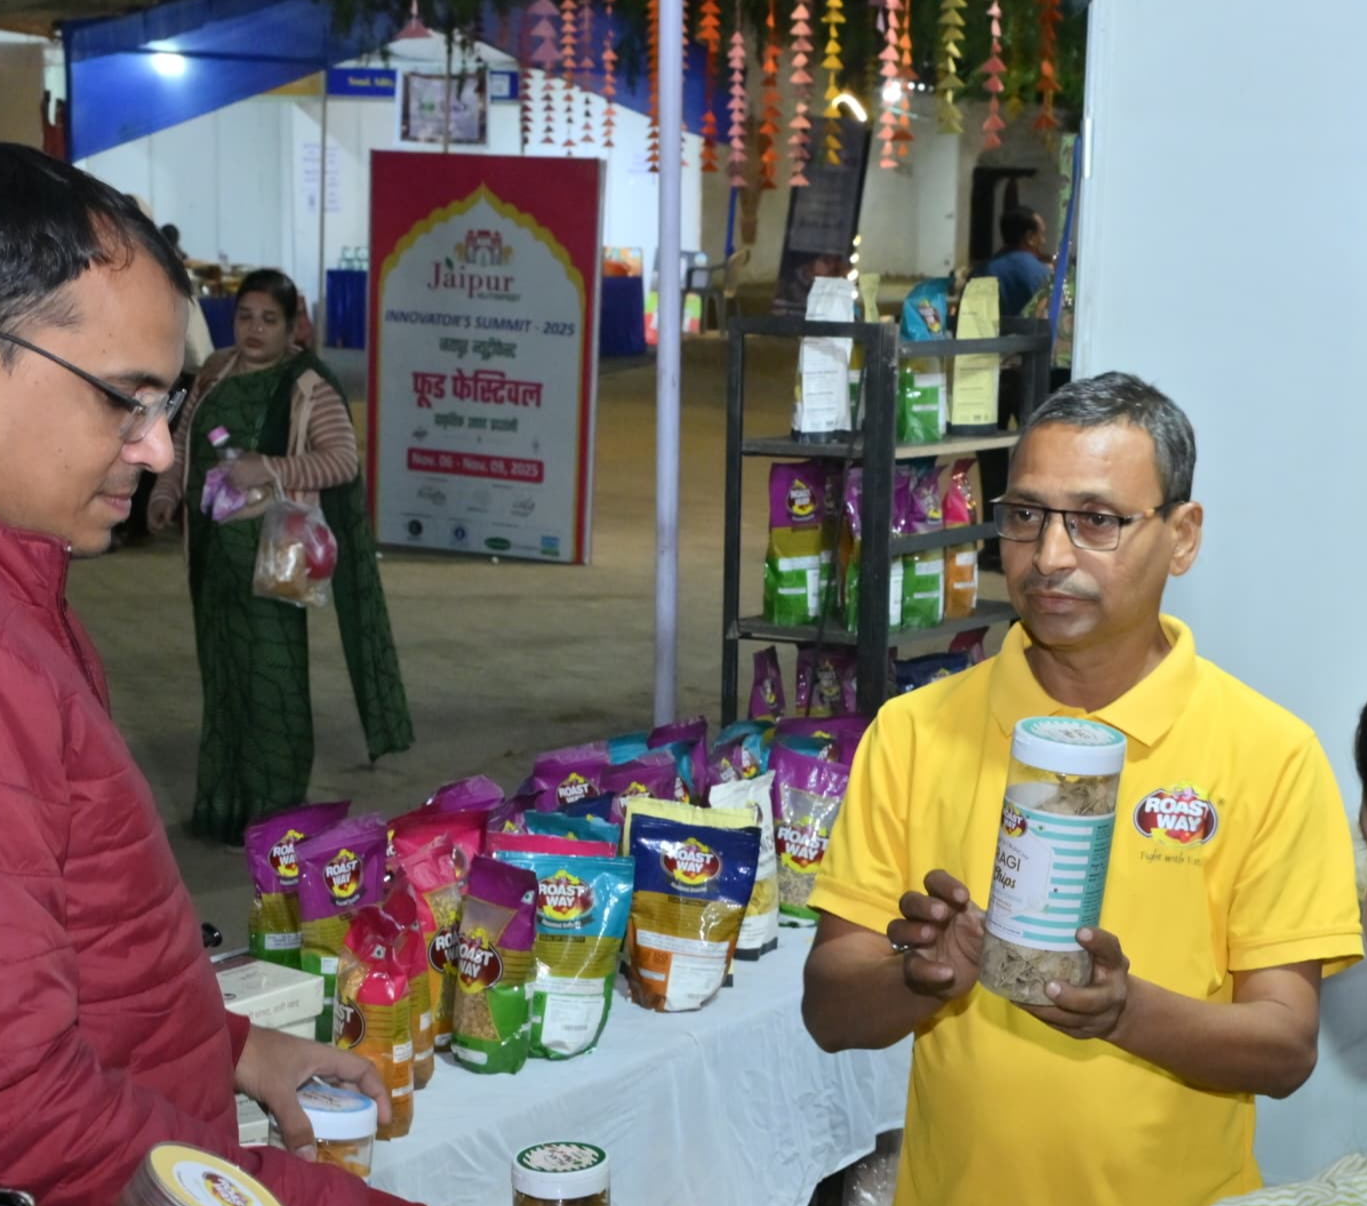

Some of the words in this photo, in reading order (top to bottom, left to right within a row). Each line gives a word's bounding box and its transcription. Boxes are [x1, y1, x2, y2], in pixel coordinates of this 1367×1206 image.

[427, 260, 515, 299] Jaipur
[385, 309, 471, 329] INNOVATOR'S
[475, 315, 533, 333] SUMMIT
[543, 321, 576, 336] 2025
[412, 370, 447, 409] फूड
[451, 368, 543, 409] फेस्टिवल
[1157, 813, 1202, 832] WAY
[778, 825, 830, 852] ROAST
[783, 841, 819, 860] WAY
[325, 860, 358, 878] ROAST
[675, 859, 704, 874] WAY
[538, 883, 586, 898] ROAST
[545, 895, 576, 910] WAY
